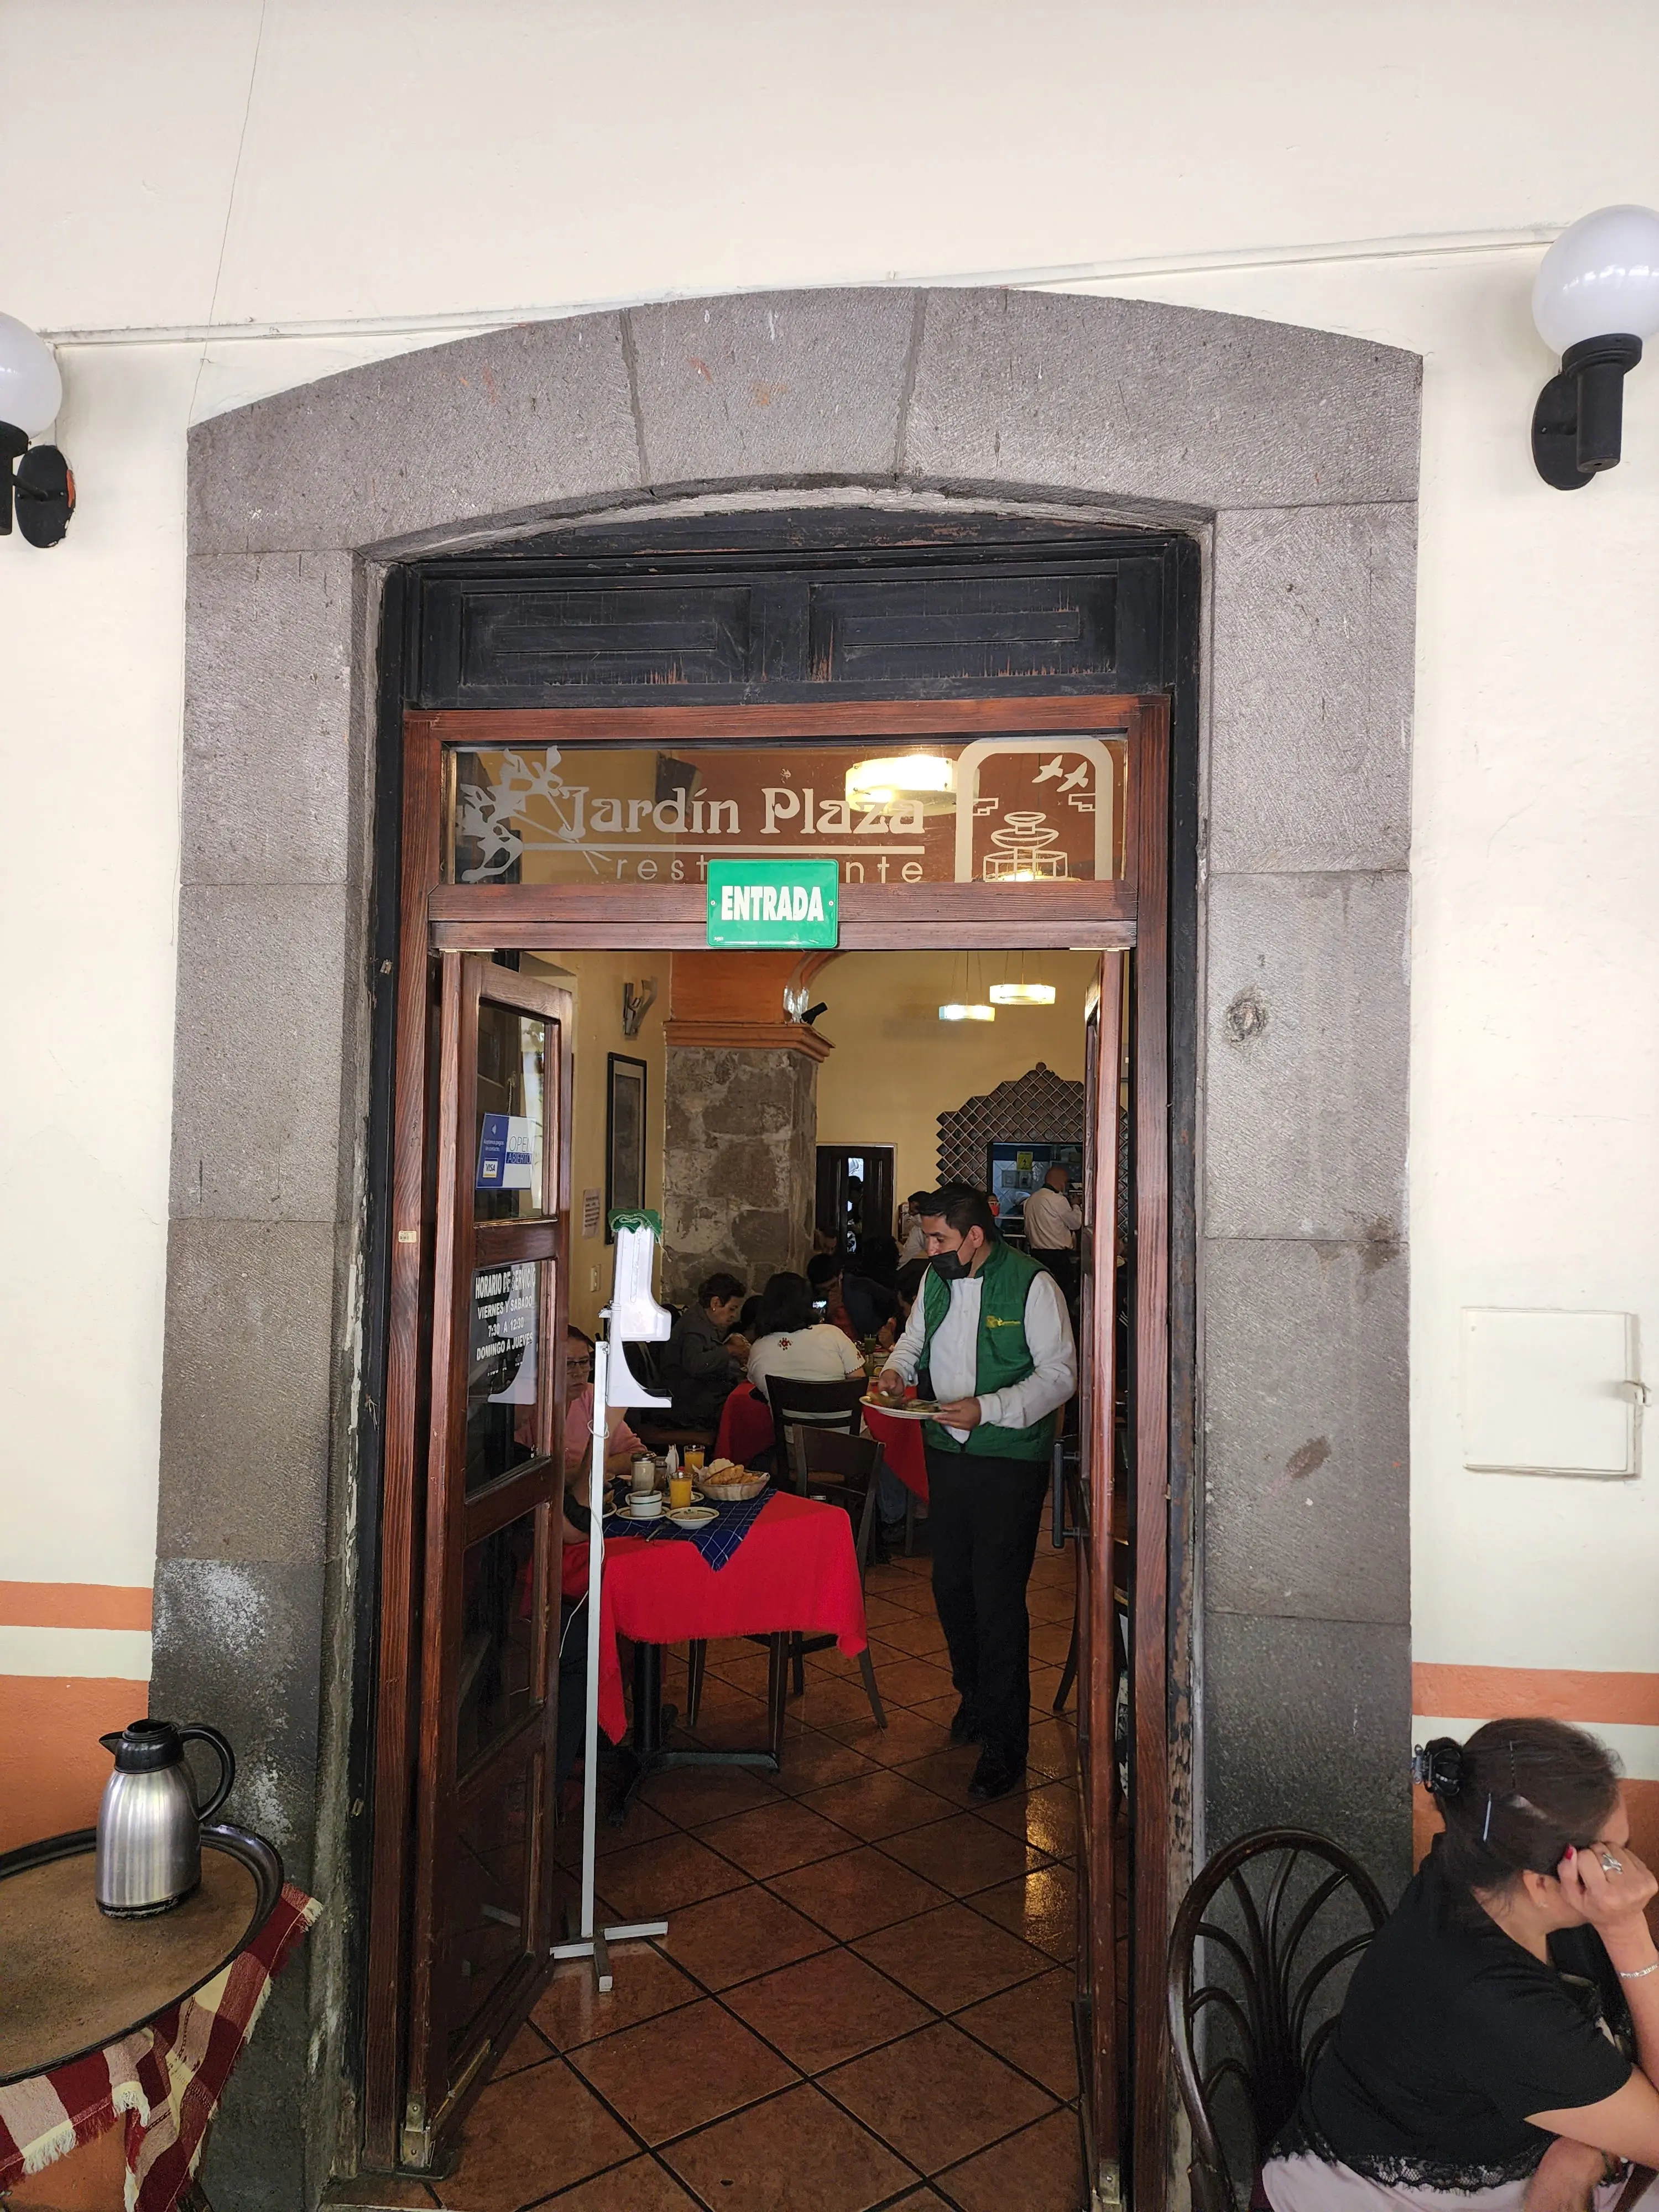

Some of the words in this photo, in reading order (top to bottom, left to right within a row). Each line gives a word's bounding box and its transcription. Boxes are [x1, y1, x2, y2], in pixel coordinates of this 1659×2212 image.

[559, 786, 741, 839] Jardín
[759, 787, 925, 834] Plaza
[616, 854, 923, 884] restnte
[721, 885, 825, 921] ENTRADA
[509, 1135, 534, 1152] OPEN
[486, 1164, 495, 1172] VISA
[508, 1153, 531, 1164] ABIERTO
[475, 1273, 502, 1300] HORARIO
[503, 1271, 511, 1293] DE
[477, 1302, 504, 1320] VIERNES
[505, 1301, 509, 1313] Y
[510, 1296, 532, 1312] SABADO
[488, 1323, 500, 1338] 7:30
[503, 1321, 508, 1333] A
[476, 1340, 505, 1361] DOMINGO
[506, 1338, 511, 1352] A
[512, 1332, 533, 1350] JUEVES
